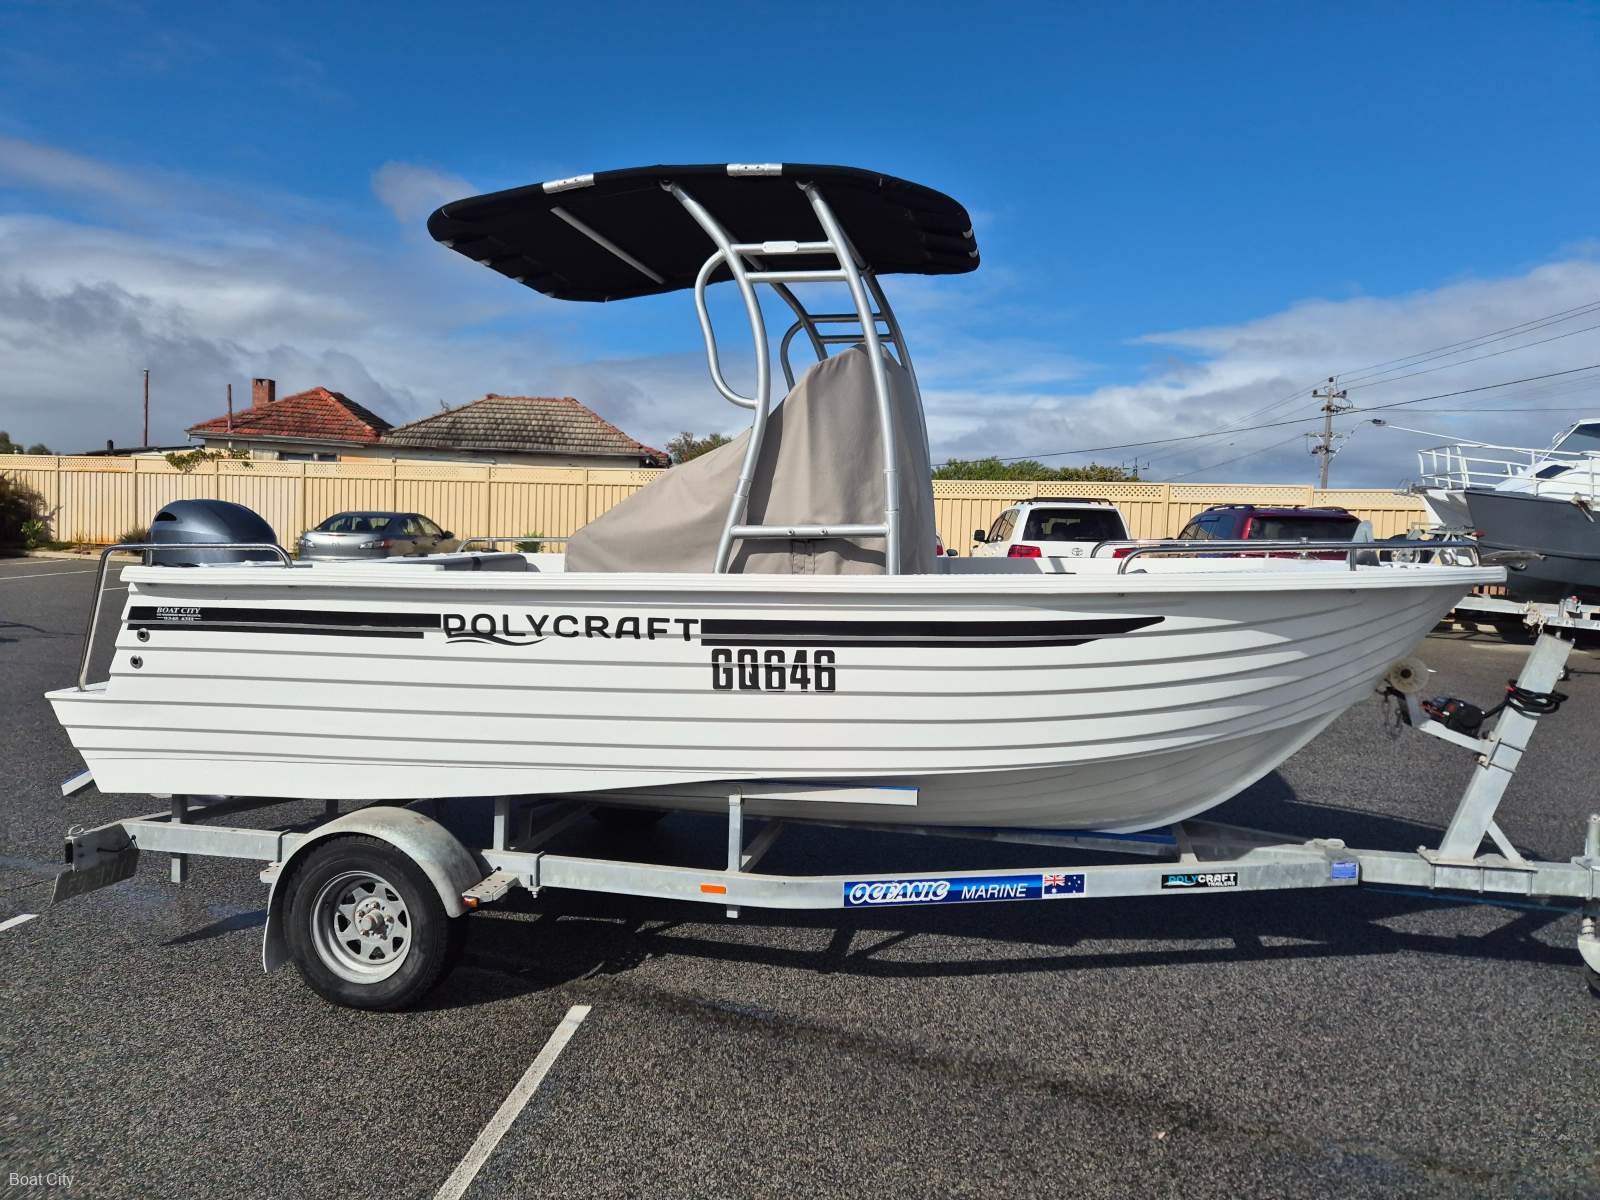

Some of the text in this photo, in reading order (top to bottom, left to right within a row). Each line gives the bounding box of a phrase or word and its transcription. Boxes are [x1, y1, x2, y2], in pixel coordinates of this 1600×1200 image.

[443, 613, 699, 643] POLYCRAFT
[712, 649, 836, 692] GQ646
[850, 880, 1028, 904] OCEANIC MARINE
[1168, 873, 1236, 884] POLYCRAFT
